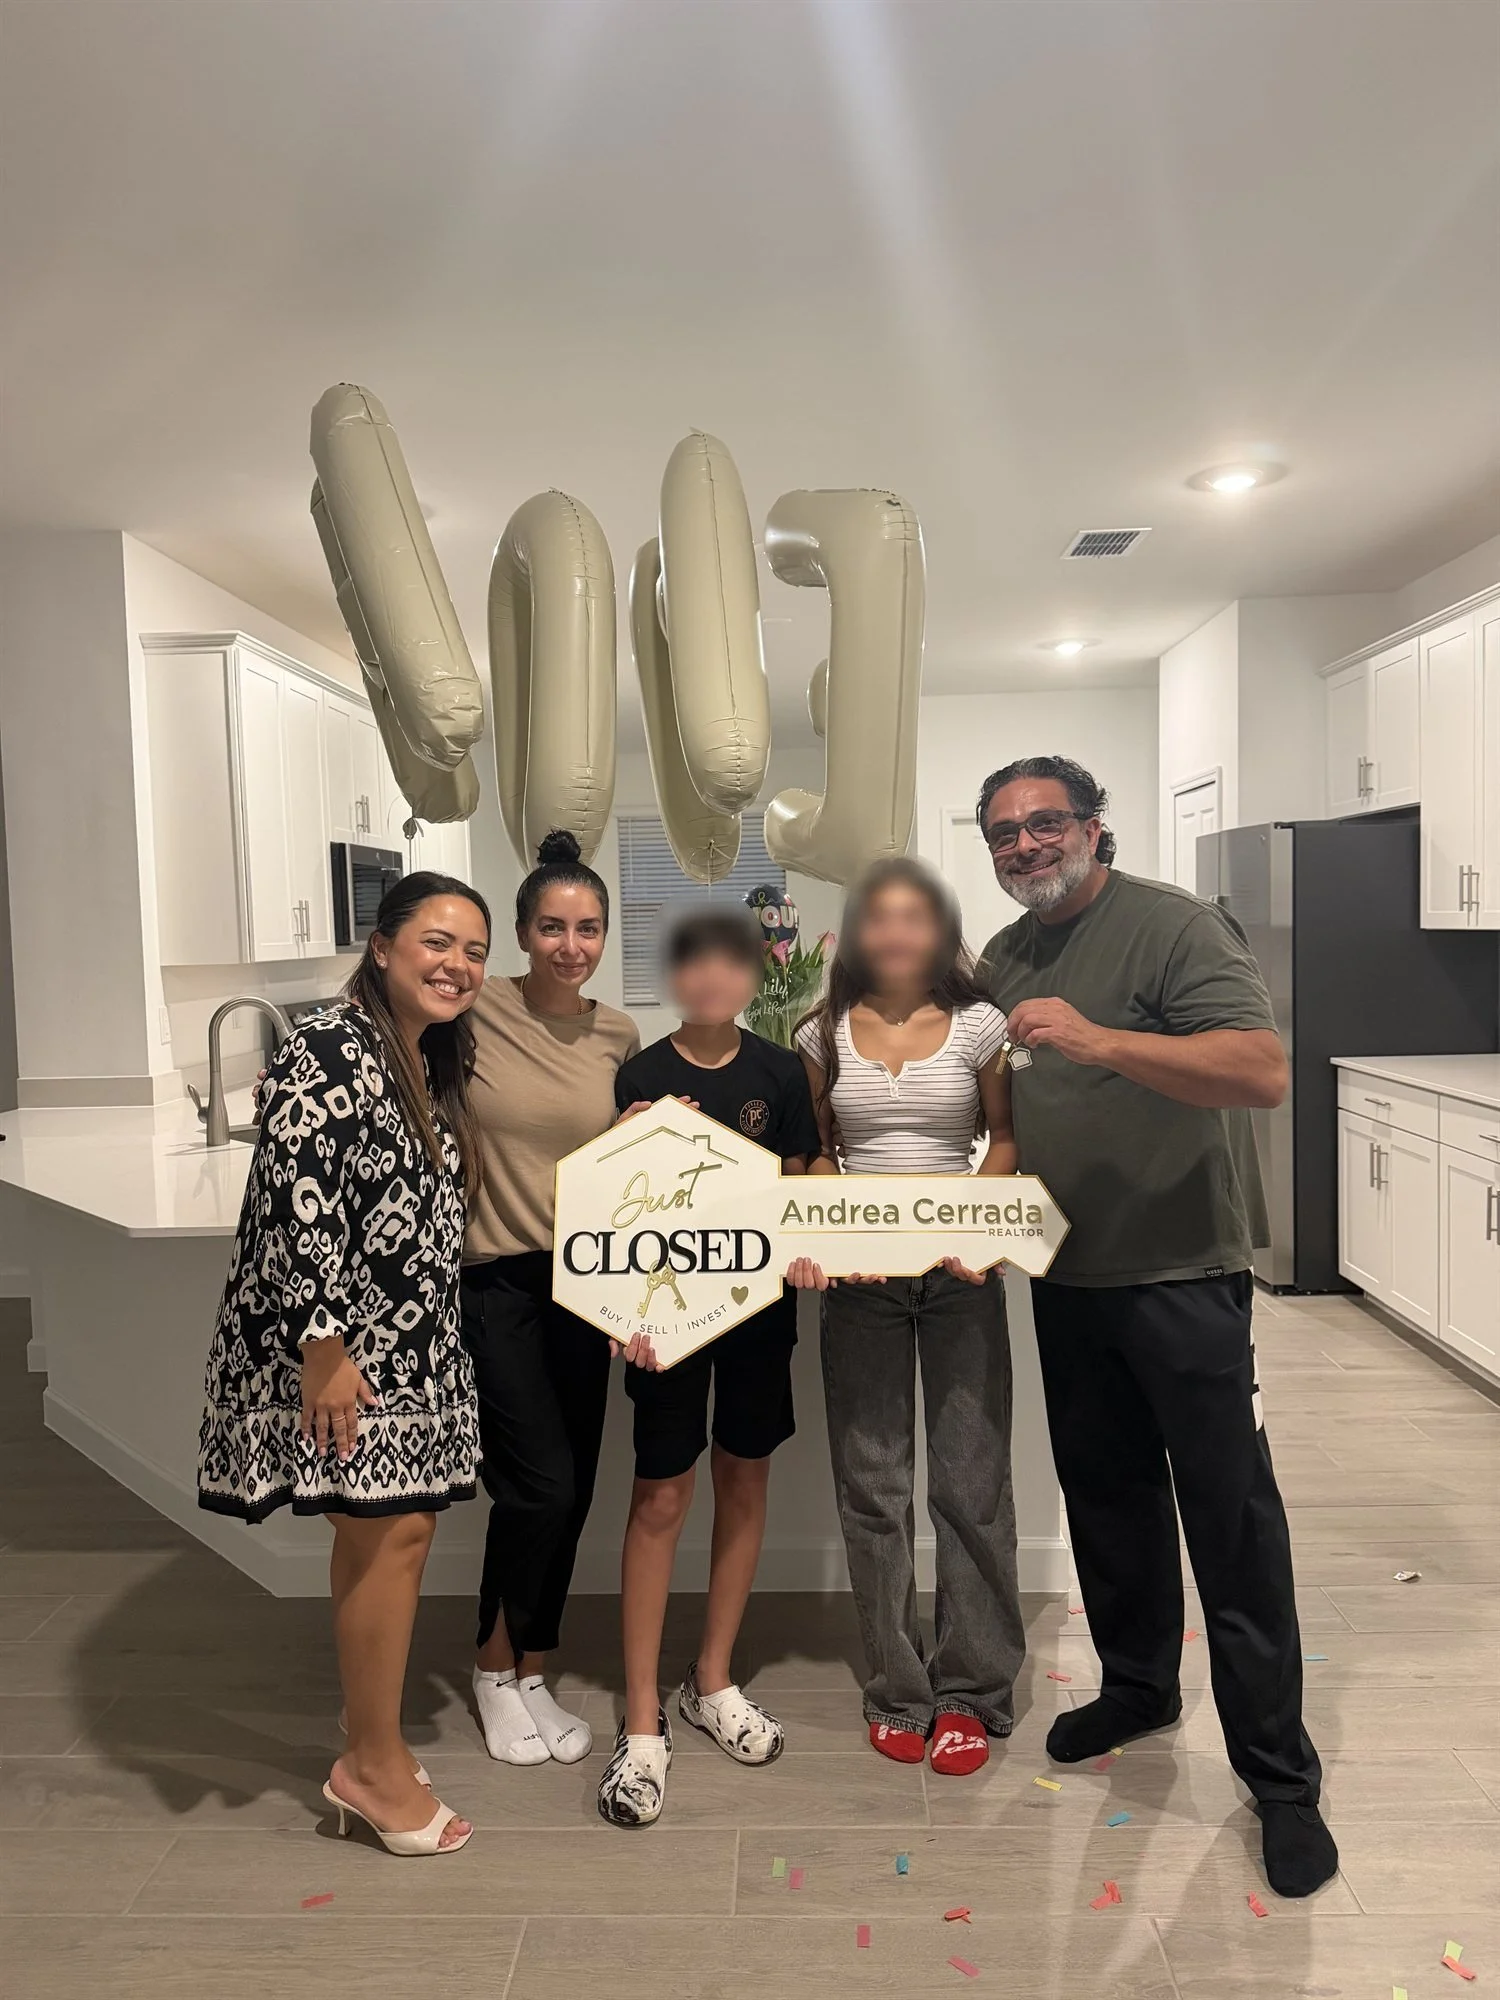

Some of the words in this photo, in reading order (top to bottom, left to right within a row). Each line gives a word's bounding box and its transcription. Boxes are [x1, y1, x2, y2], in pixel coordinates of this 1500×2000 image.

[611, 1161, 723, 1229] Just
[780, 1197, 900, 1226] Andrea
[912, 1197, 1043, 1226] Cerrada
[988, 1228, 1044, 1237] REALTOR
[563, 1229, 772, 1276] CLOSED
[599, 1306, 623, 1323] BUY
[640, 1323, 668, 1335] SELL
[687, 1304, 728, 1330] INVEST
